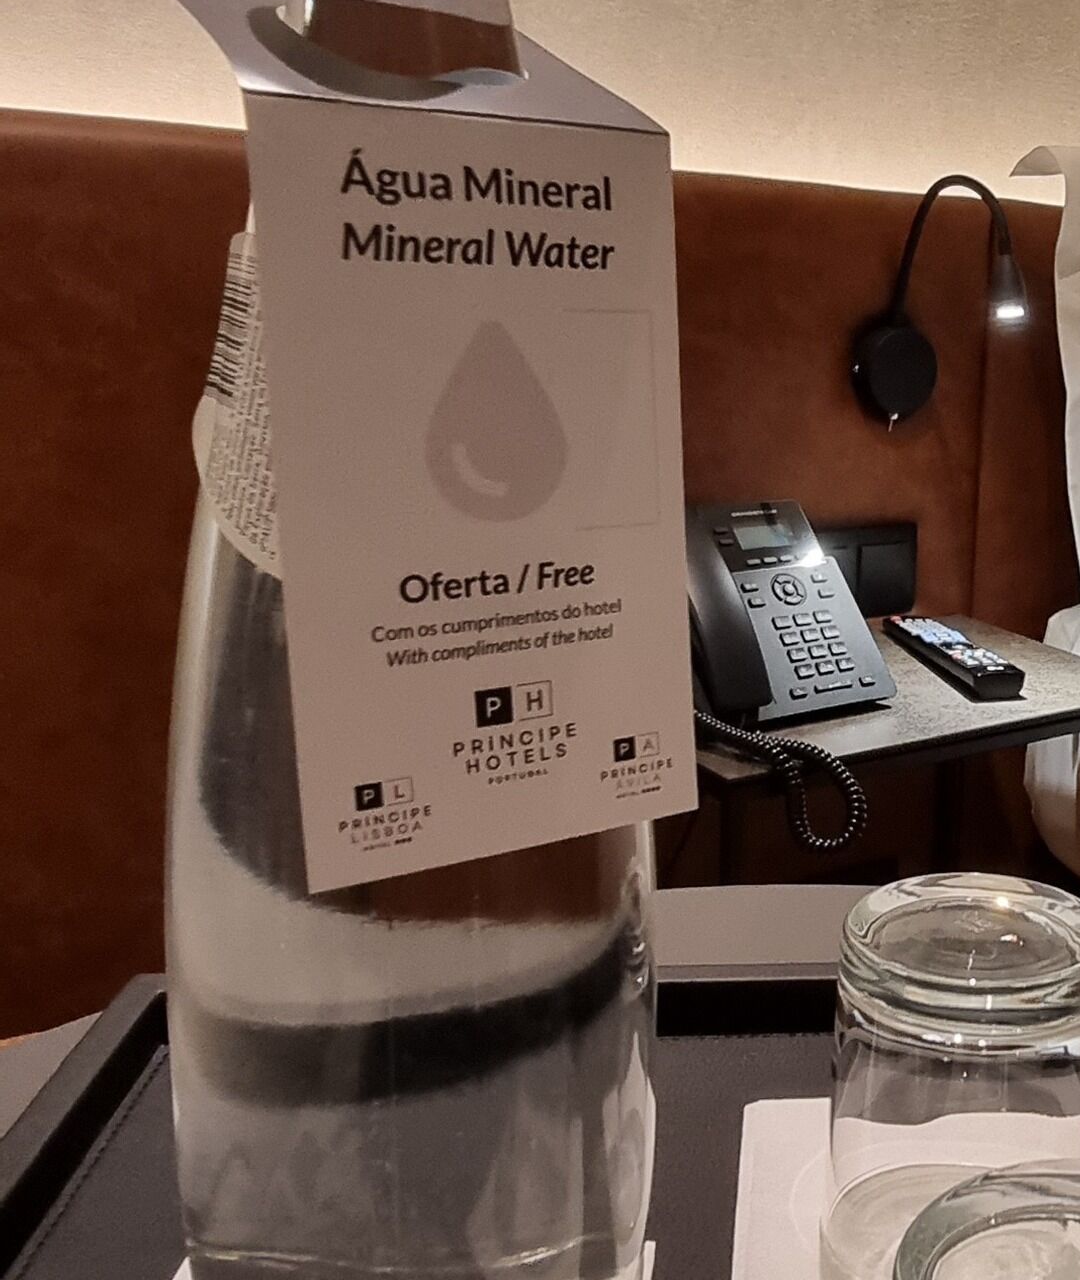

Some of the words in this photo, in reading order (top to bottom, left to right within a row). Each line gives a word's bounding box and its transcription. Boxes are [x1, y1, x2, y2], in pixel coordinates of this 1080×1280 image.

[340, 148, 453, 206] Água
[462, 165, 612, 211] Mineral
[341, 222, 495, 266] Mineral
[505, 230, 615, 270] Water
[400, 569, 511, 604] Oferta
[516, 563, 530, 594] /
[537, 561, 596, 591] Free
[371, 625, 415, 643] Com
[417, 623, 438, 638] os
[441, 607, 560, 633] cumprimentos
[561, 603, 582, 621] do
[583, 598, 623, 616] hotel
[386, 648, 429, 668] With
[431, 635, 532, 662] compliments
[534, 631, 550, 650] of
[551, 628, 576, 646] the
[577, 622, 614, 642] hotel
[485, 696, 502, 718] P
[525, 688, 544, 713] H
[465, 742, 568, 775] HOTELS
[487, 768, 550, 785] PORTUGAL
[351, 820, 423, 844] LISBOA
